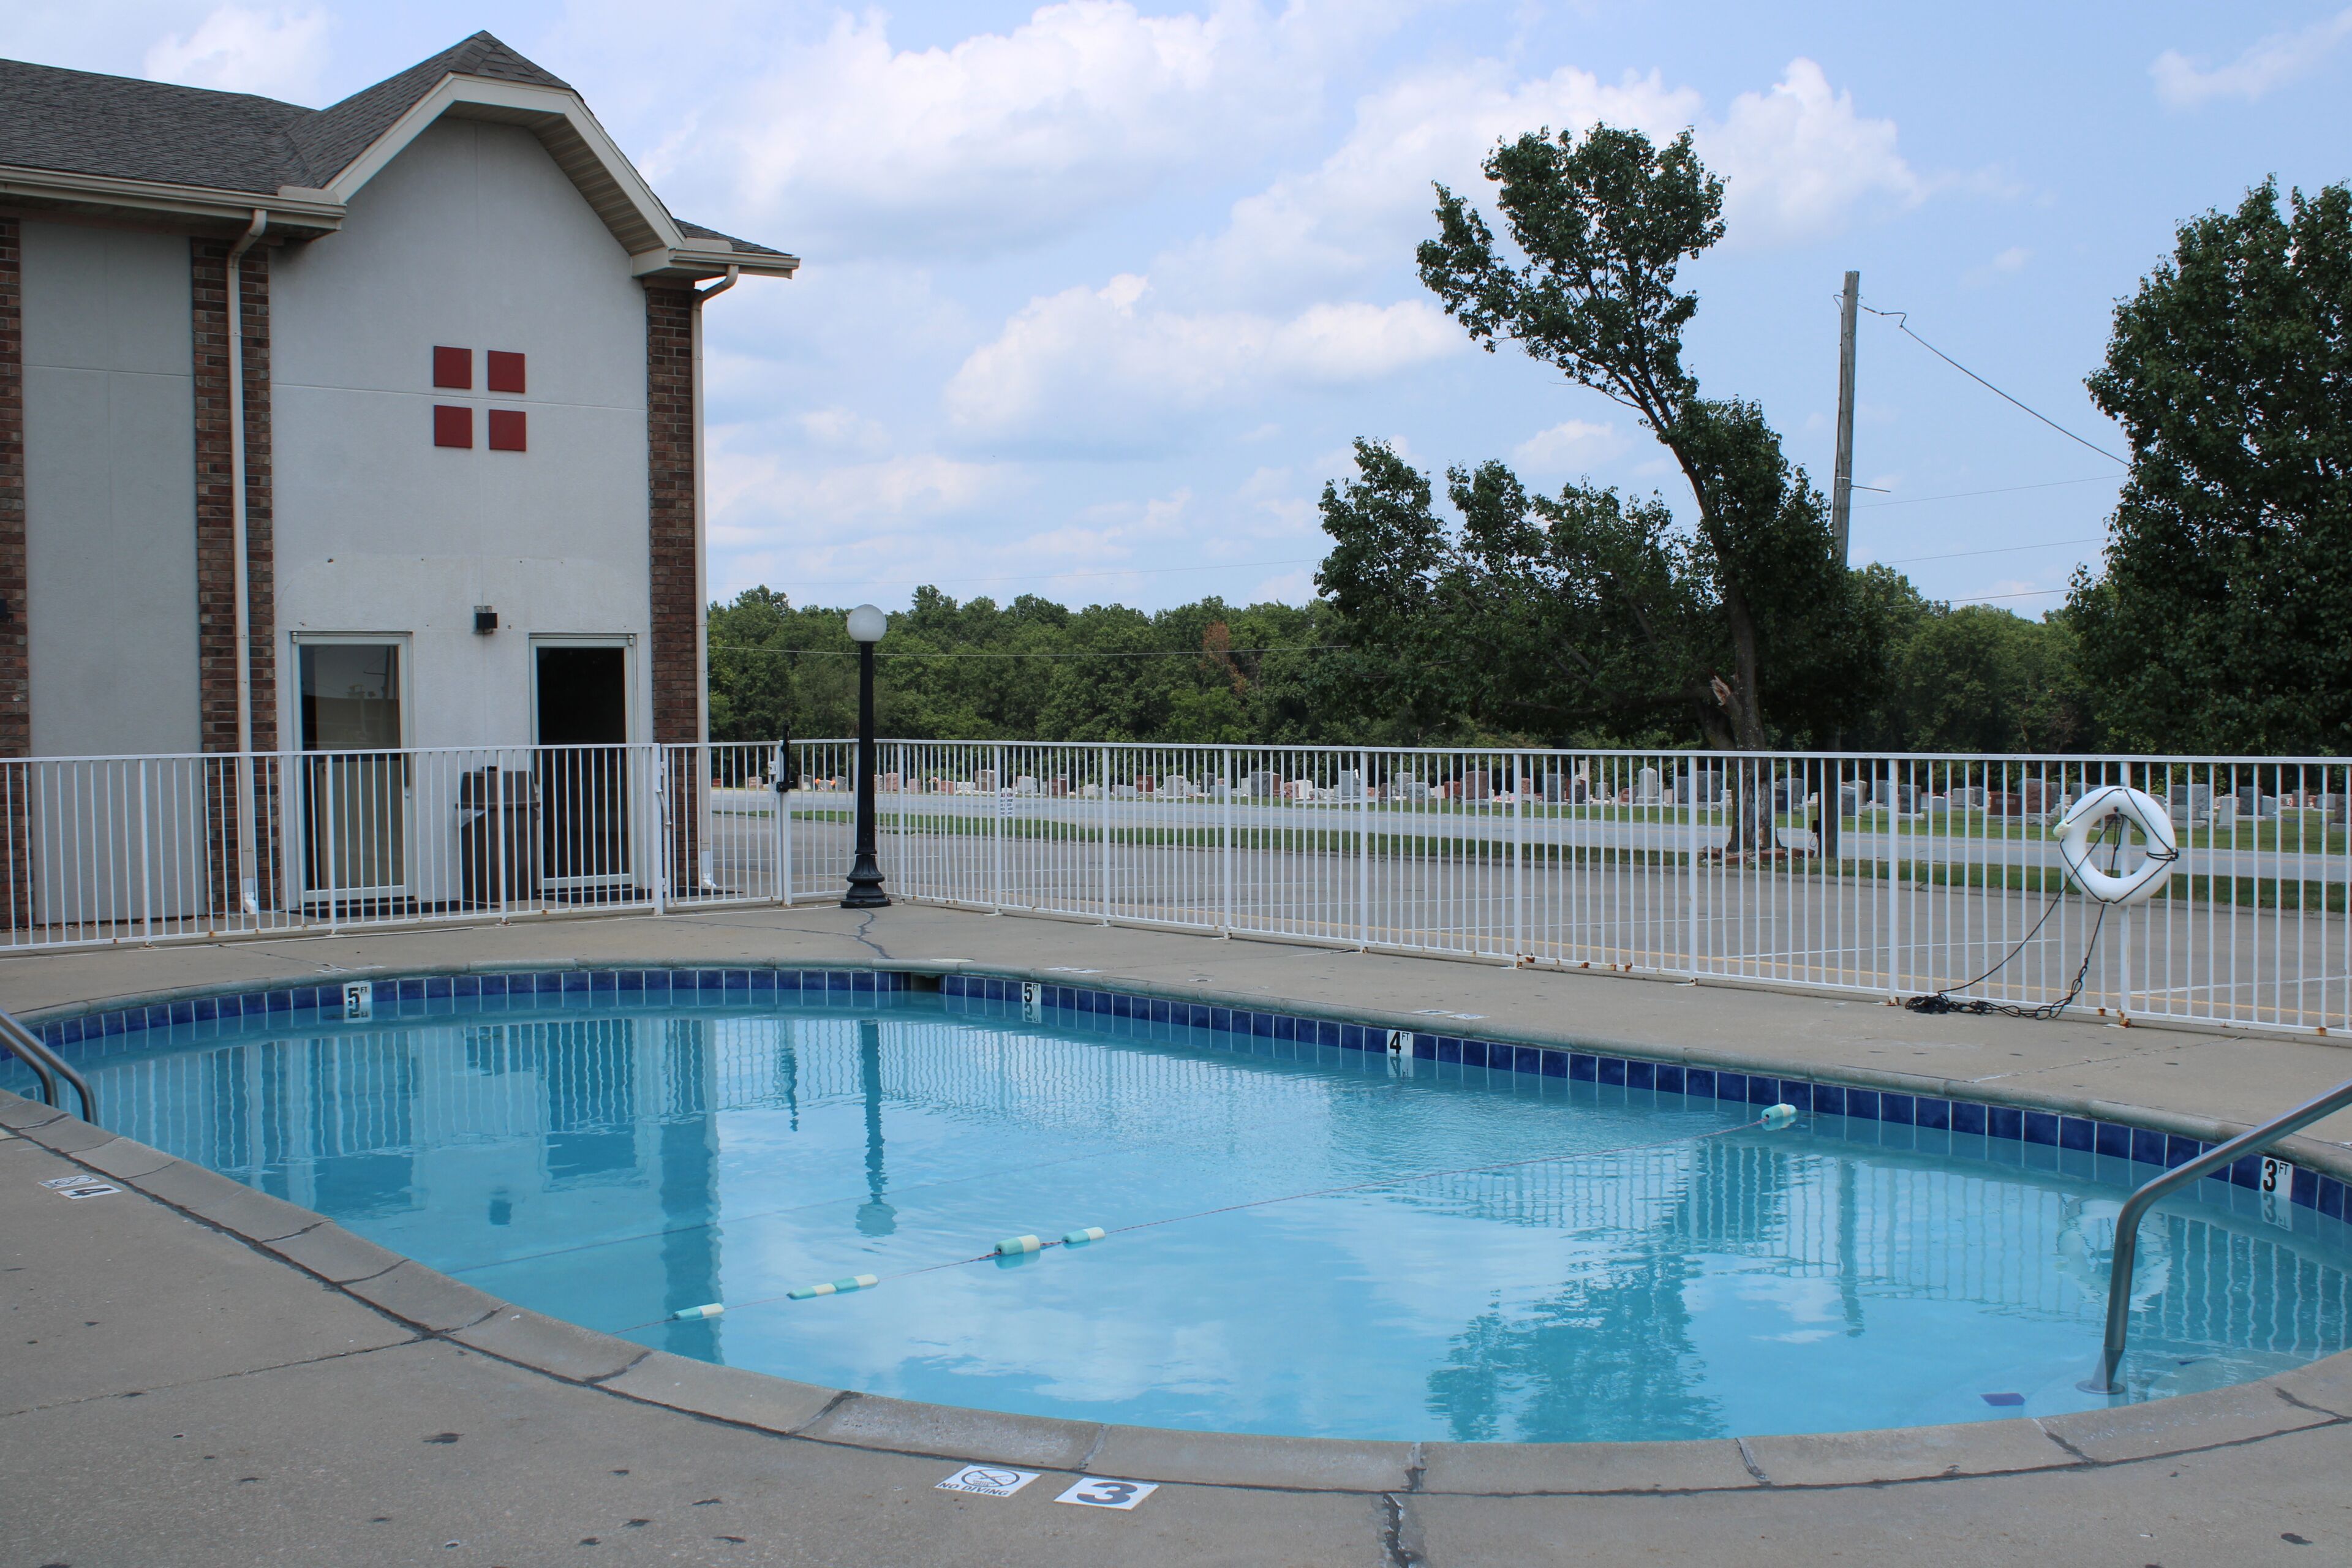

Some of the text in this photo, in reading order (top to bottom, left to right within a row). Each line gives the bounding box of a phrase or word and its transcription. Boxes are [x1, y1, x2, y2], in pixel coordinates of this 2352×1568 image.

[348, 987, 360, 1003] 5
[1024, 983, 1033, 1003] 5
[1389, 1031, 1410, 1054] 4 FT
[2263, 1159, 2290, 1192] 3 FT
[960, 1486, 1009, 1496] DIVING
[1076, 1482, 1138, 1505] 3
